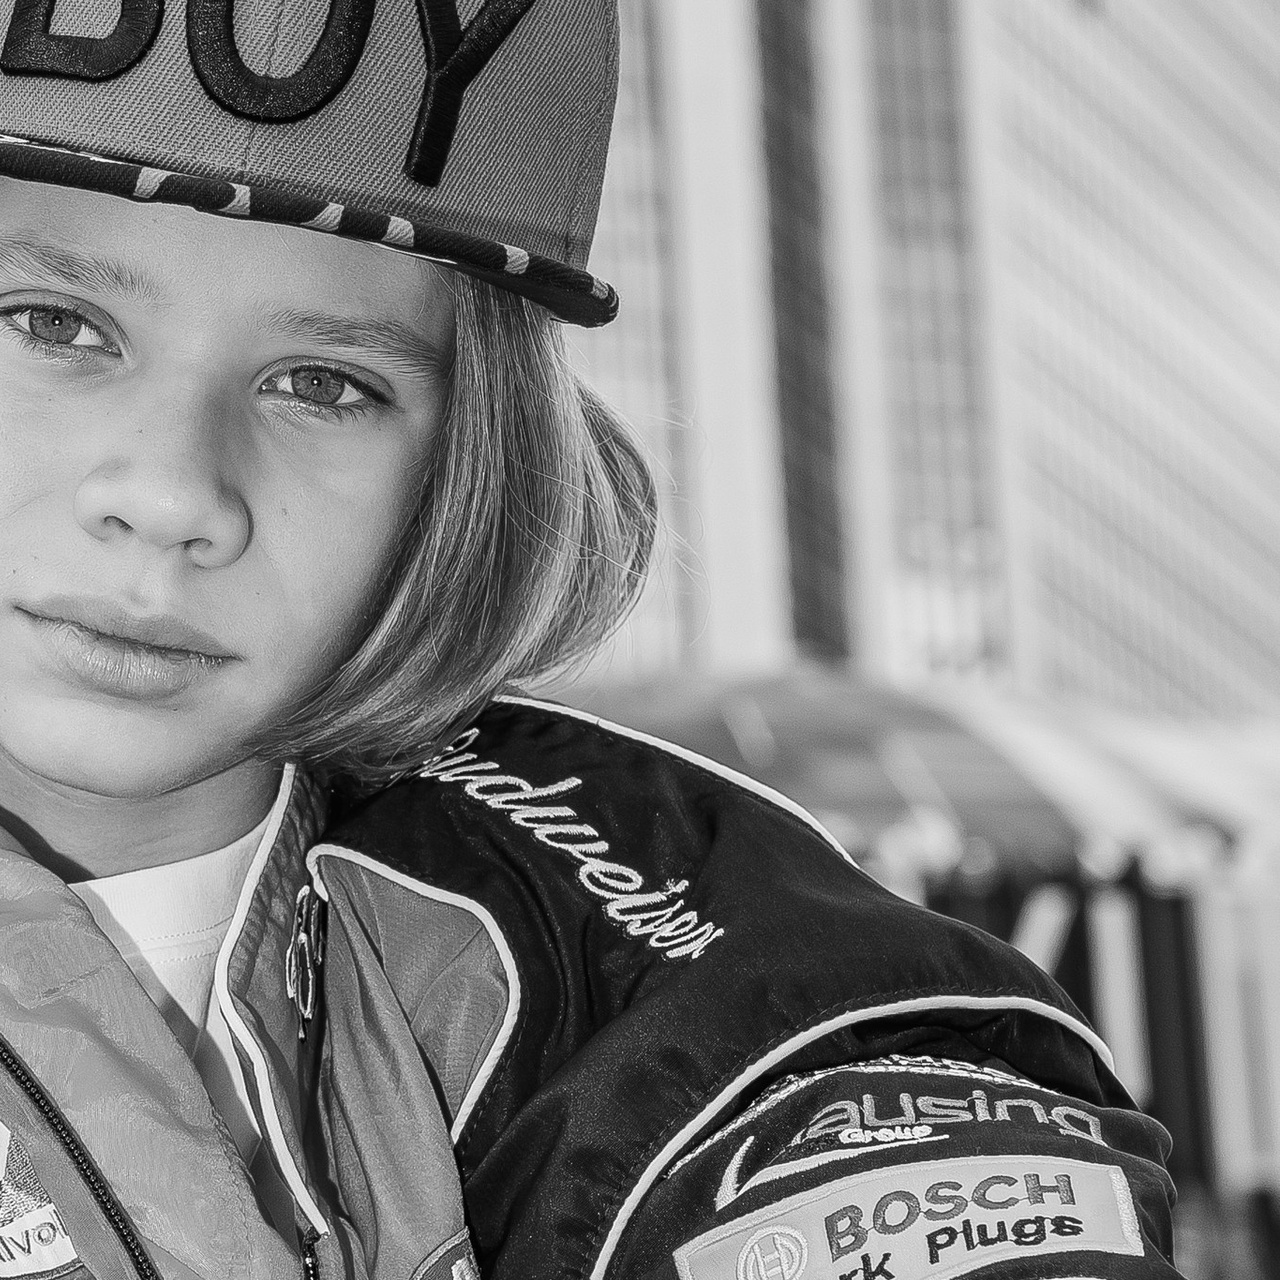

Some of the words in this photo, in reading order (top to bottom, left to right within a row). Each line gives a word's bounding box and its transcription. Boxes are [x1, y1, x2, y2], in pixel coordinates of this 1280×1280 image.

[419, 728, 725, 959] udweiser
[824, 1173, 1076, 1262] BOSCH
[926, 1213, 1084, 1265] Plugs
